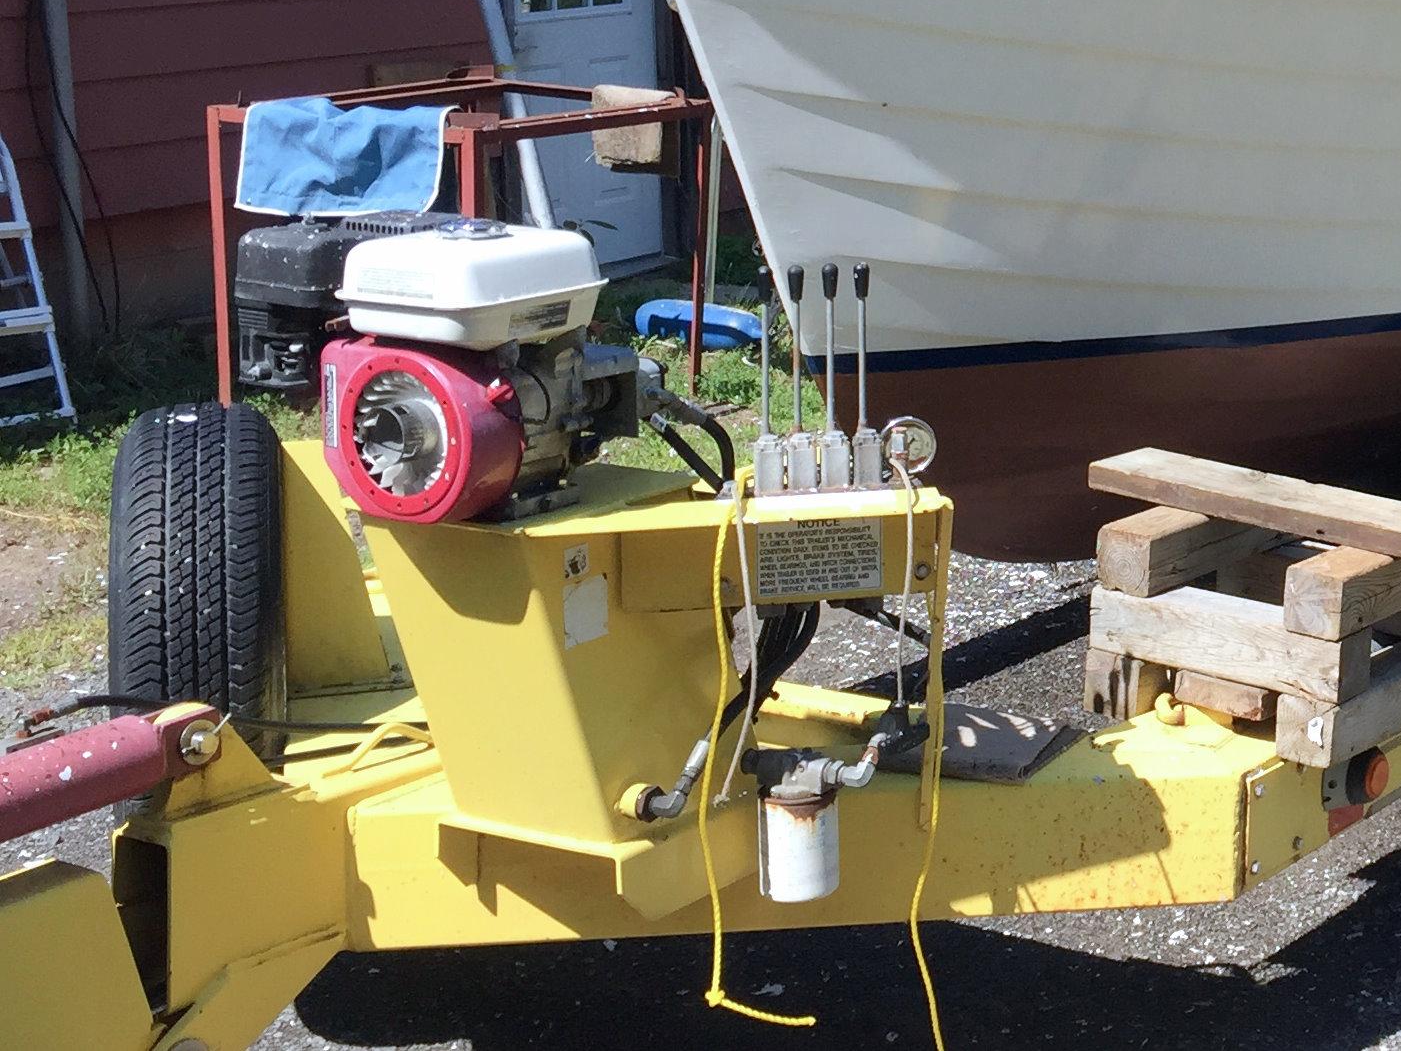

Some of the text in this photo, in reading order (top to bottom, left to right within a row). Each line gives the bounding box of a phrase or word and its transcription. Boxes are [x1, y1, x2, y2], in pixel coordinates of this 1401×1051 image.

[797, 519, 840, 528] NOTICE
[825, 526, 870, 535] RESPONSIBILITY
[838, 534, 873, 542] MECHANICAL
[759, 547, 791, 555] CONDITION
[851, 541, 878, 549] CHECKED
[779, 577, 807, 585] FREQUENT
